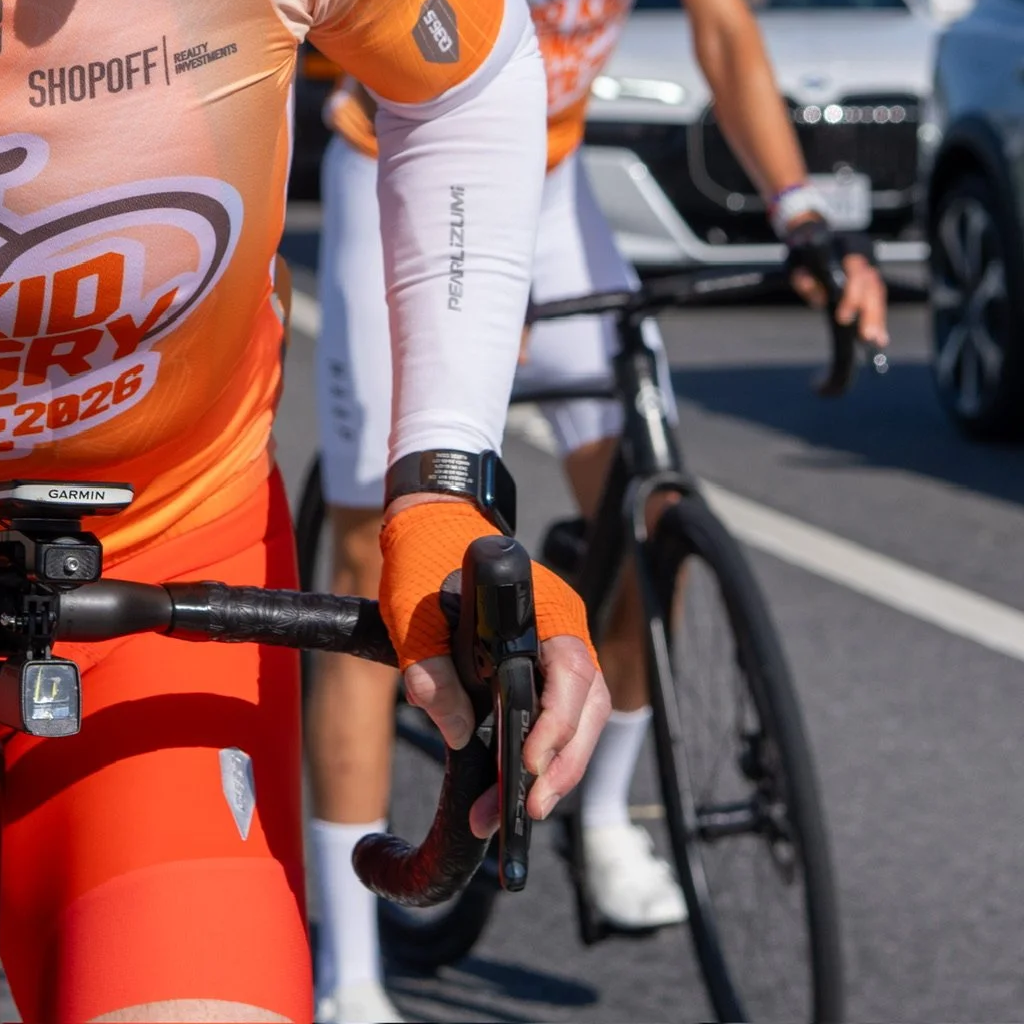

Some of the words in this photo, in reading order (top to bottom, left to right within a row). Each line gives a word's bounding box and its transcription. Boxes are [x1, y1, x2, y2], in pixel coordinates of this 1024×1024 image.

[173, 41, 208, 64] REALTY
[174, 42, 238, 75] INVESTMENTS
[28, 45, 158, 108] SHOPOFF
[12, 363, 145, 437] 2026
[48, 489, 106, 501] GARMIN
